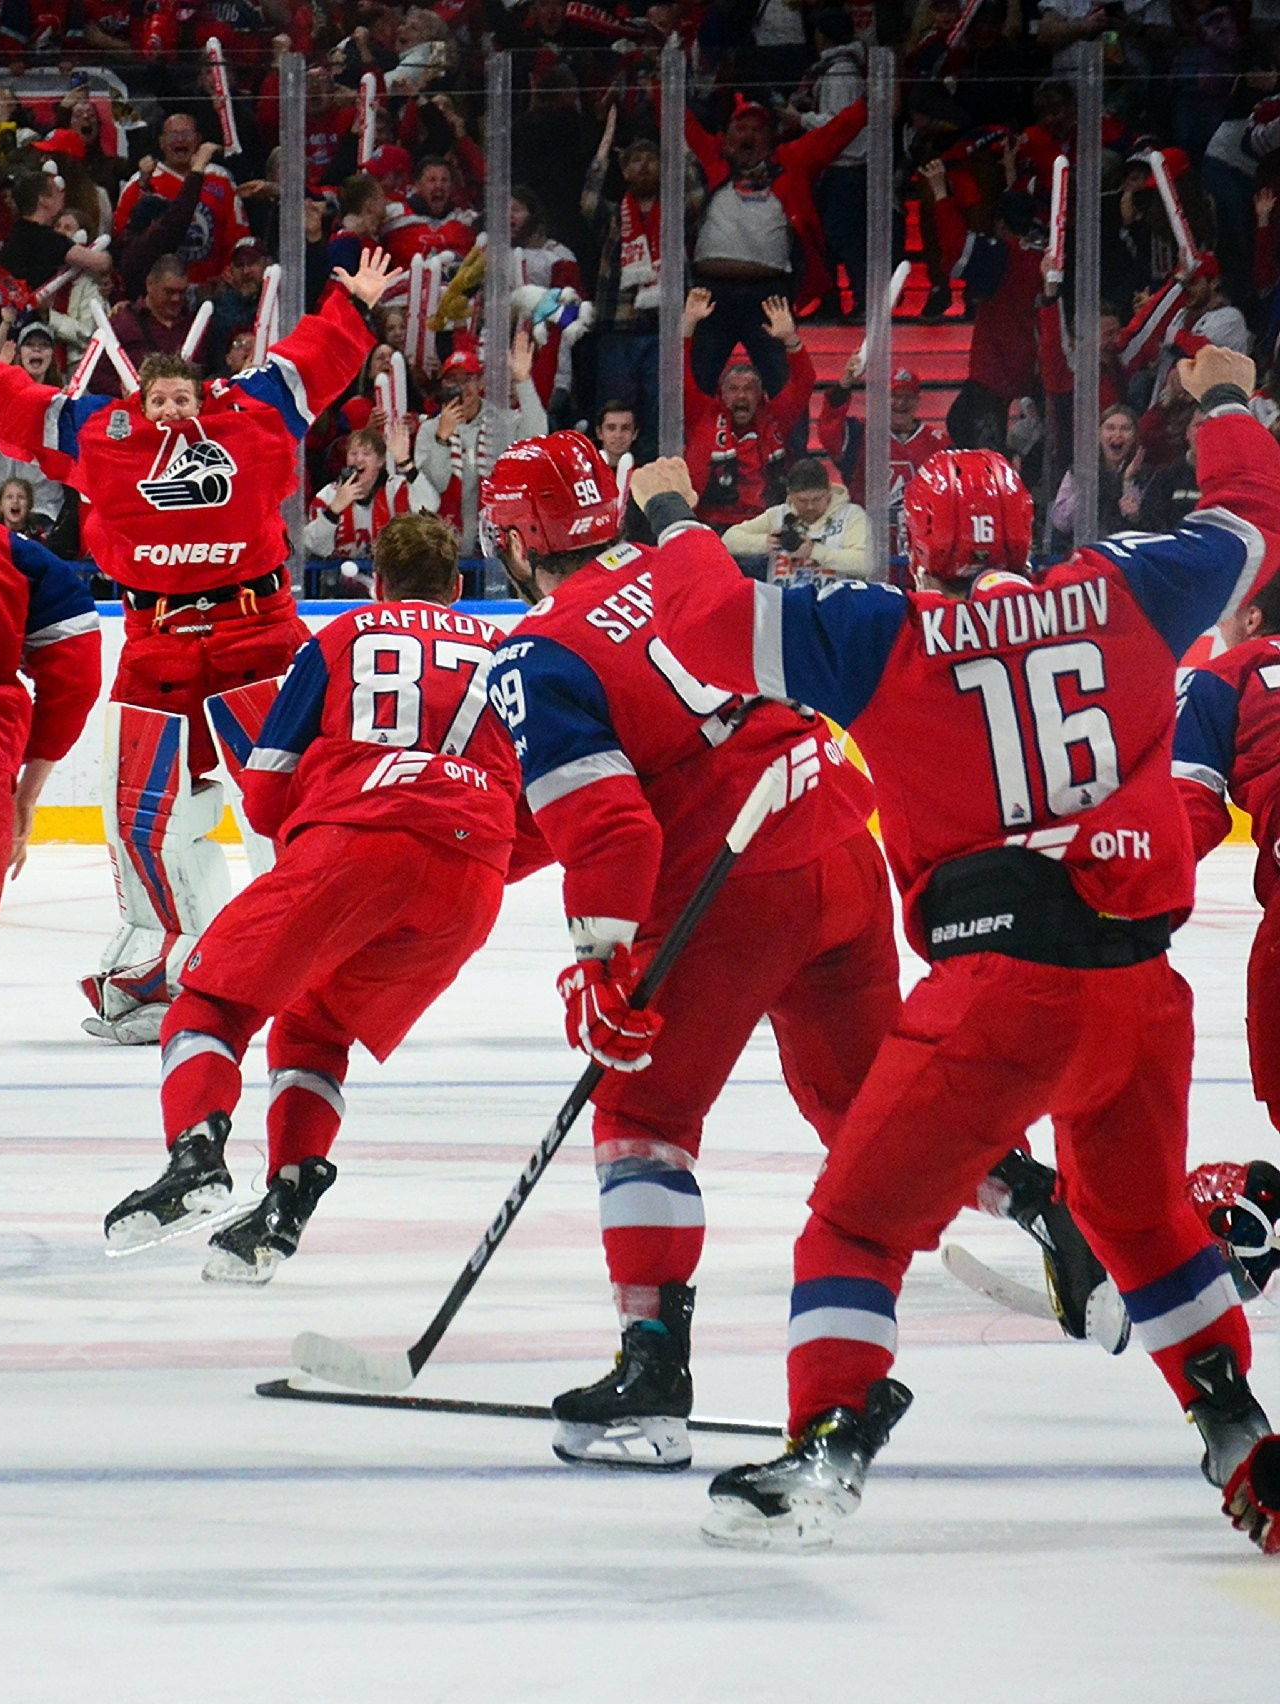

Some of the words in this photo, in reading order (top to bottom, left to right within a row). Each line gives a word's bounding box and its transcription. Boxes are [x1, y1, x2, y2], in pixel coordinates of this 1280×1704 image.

[574, 479, 601, 507] 99
[970, 515, 995, 543] 16
[133, 542, 247, 565] FONBET
[353, 609, 497, 643] RAFIKOV
[922, 577, 1108, 656] KAYUMOV
[351, 633, 495, 757] 87
[954, 641, 1121, 827] 16
[443, 760, 488, 791] ФГК
[1090, 829, 1151, 860] ФГК
[931, 913, 1015, 944] BAUER
[470, 1119, 561, 1273] SOYUZ
